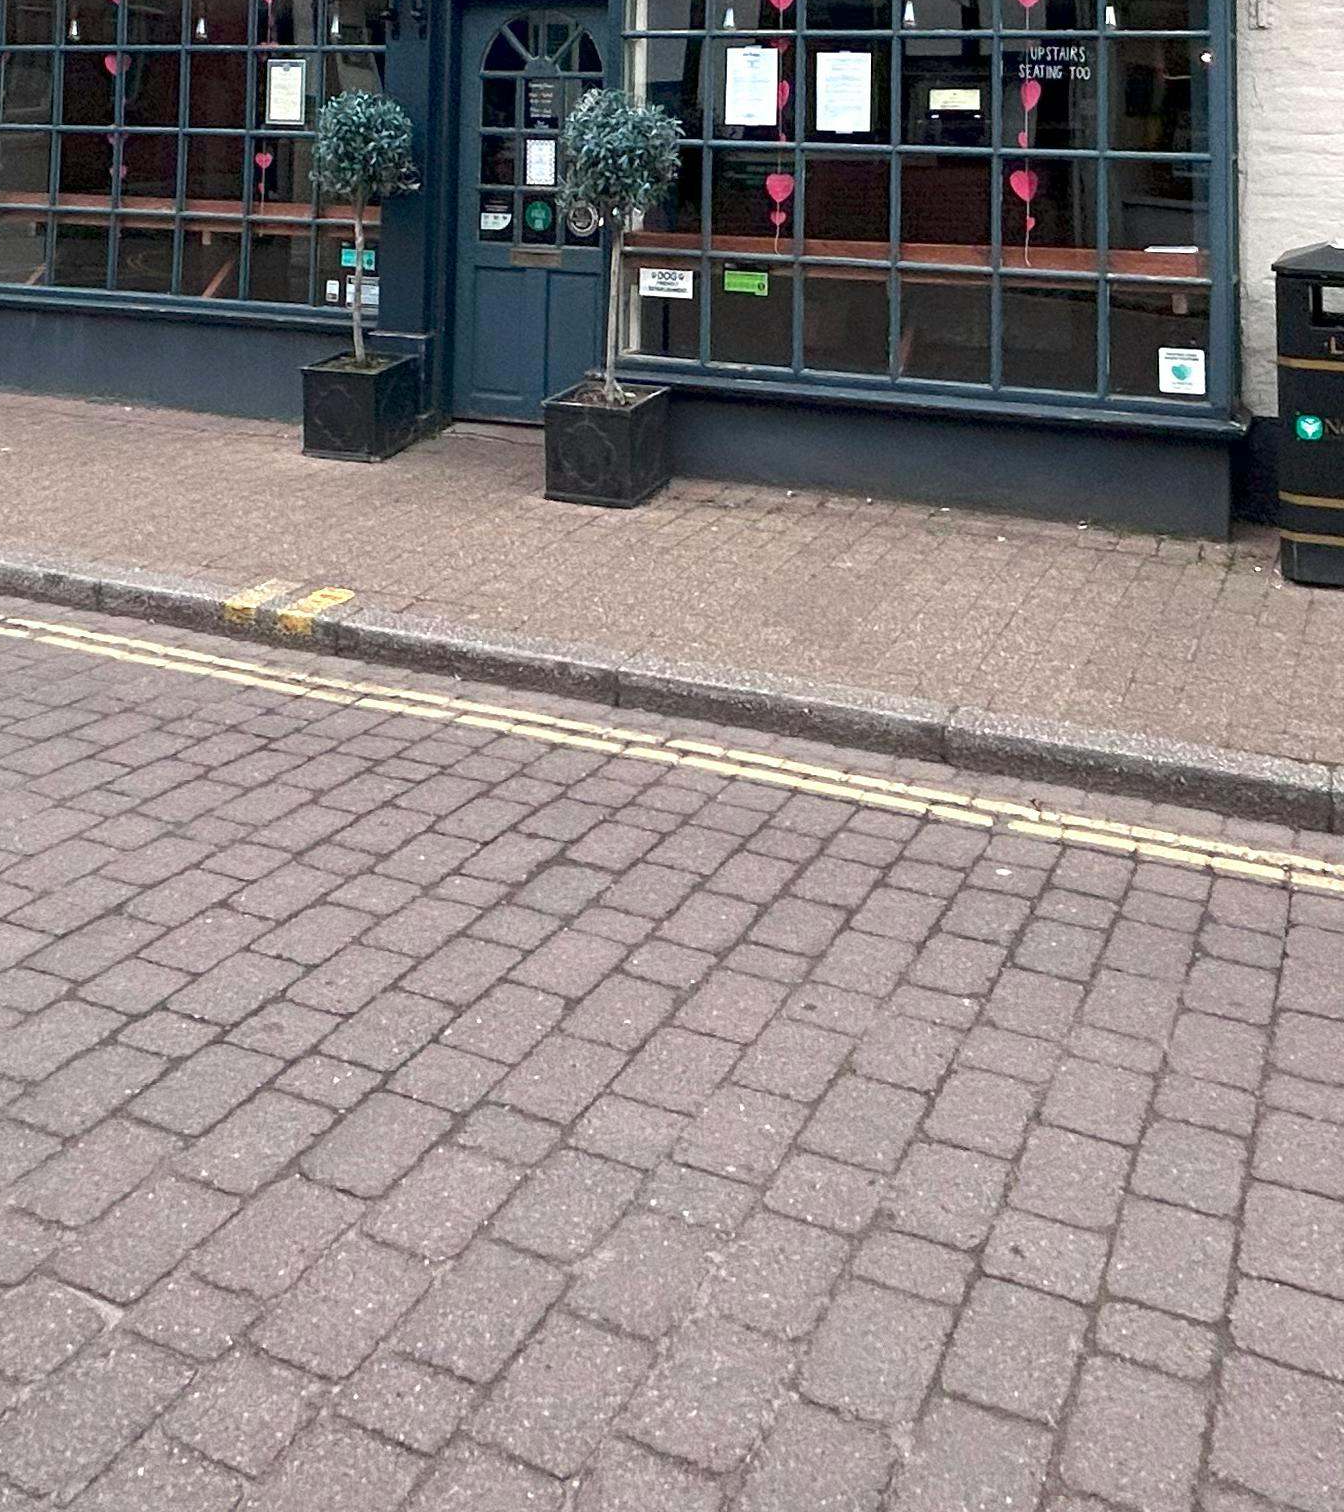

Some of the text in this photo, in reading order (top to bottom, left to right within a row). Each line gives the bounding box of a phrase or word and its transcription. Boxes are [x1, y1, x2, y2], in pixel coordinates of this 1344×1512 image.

[1029, 46, 1086, 62] UPSTAIRS
[1018, 63, 1091, 80] SEATING TOO
[658, 271, 677, 281] DOG
